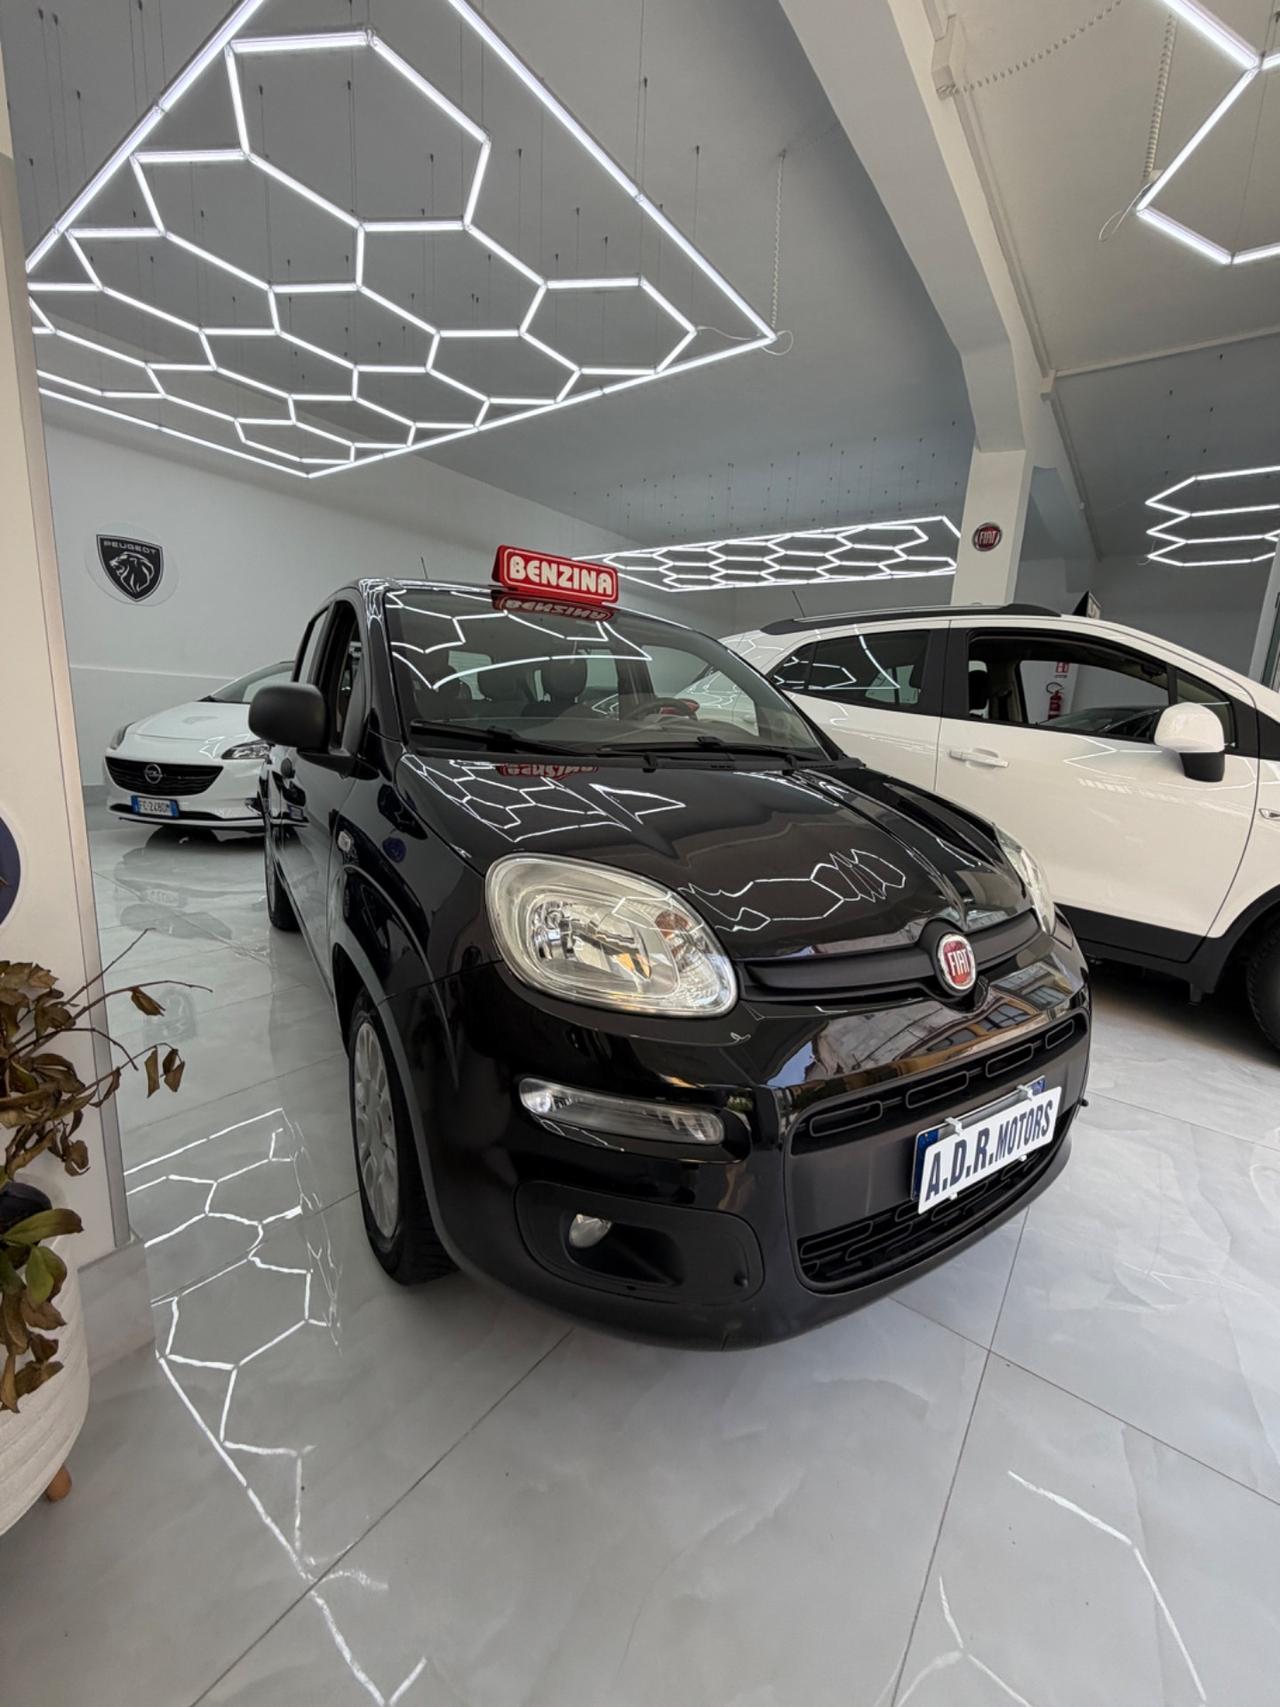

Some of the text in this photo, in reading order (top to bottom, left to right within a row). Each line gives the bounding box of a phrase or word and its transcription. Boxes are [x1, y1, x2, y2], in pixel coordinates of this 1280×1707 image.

[103, 540, 156, 554] PEUGEOT
[980, 530, 998, 545] FIAT
[509, 555, 612, 595] BENZINA
[947, 949, 970, 977] FIAT
